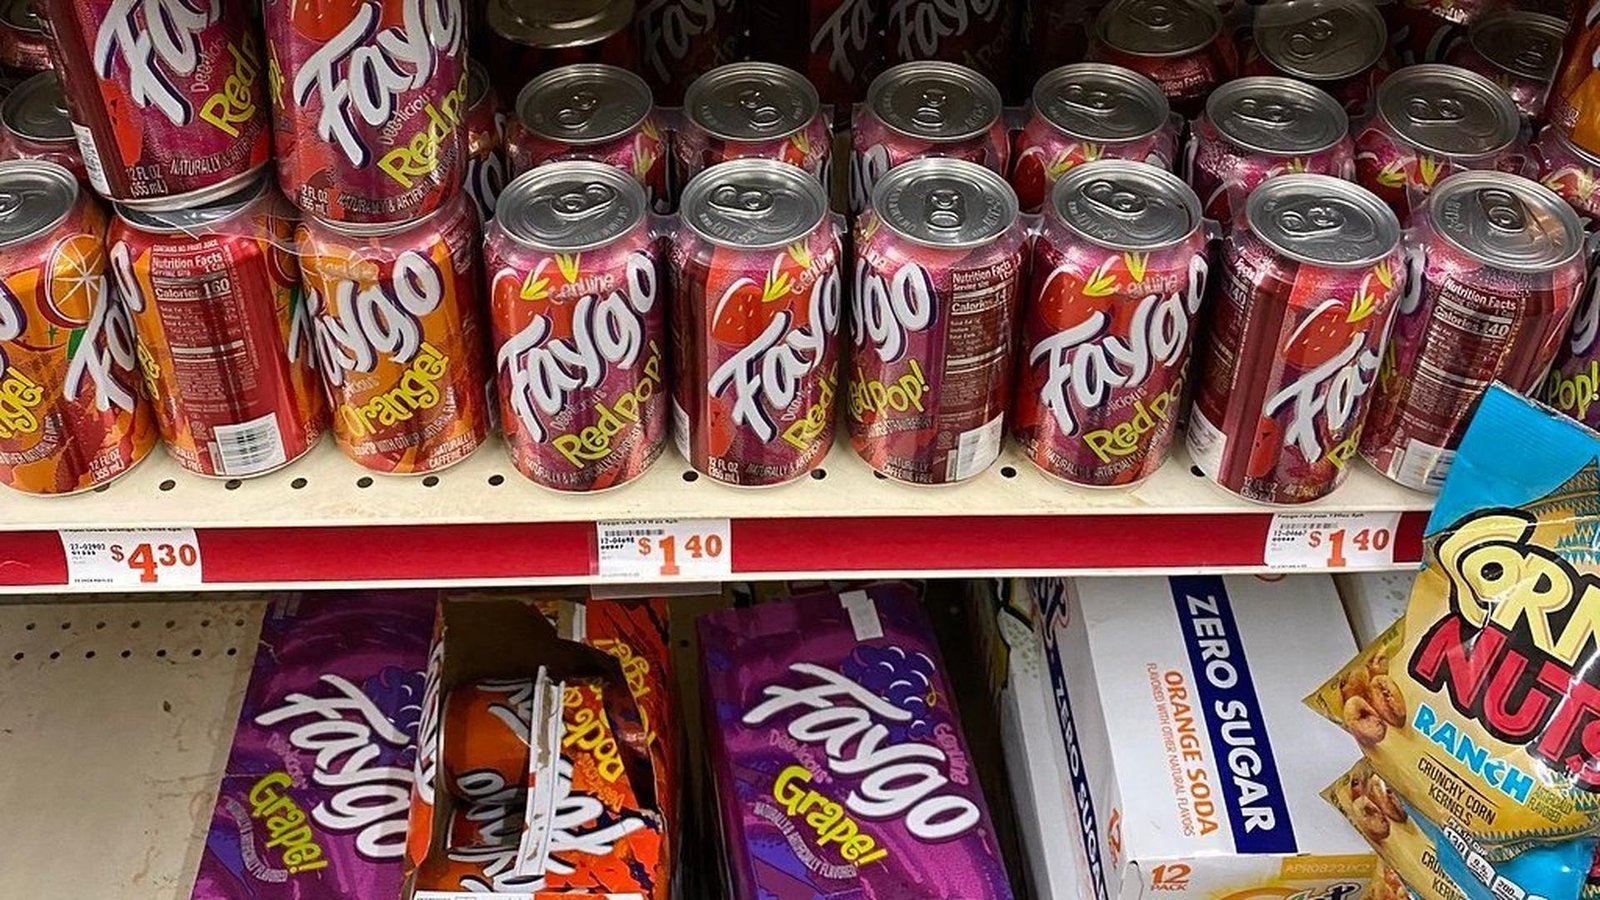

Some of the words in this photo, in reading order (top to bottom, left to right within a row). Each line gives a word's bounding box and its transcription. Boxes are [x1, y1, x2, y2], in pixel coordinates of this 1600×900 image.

[152, 256, 194, 269] Nutrition
[195, 252, 222, 266] Facts
[155, 288, 200, 299] Calories
[203, 278, 230, 299] 160
[1444, 278, 1488, 305] Nutrition
[1488, 295, 1516, 310] Facts
[498, 250, 656, 443] Faygo
[1030, 253, 1209, 438] Faygo
[1433, 304, 1480, 331] Calories
[1482, 318, 1509, 337] 140
[340, 341, 449, 438] Orange!
[1147, 662, 1165, 702] FLAVORED
[1055, 679, 1080, 778] ZERO
[1157, 702, 1170, 727] WITH
[1161, 725, 1176, 756] OTHER
[1186, 595, 1239, 690] ZERO
[1215, 699, 1277, 834] SUGAR
[742, 662, 981, 839] Faygo
[933, 722, 970, 787] Genuine
[1164, 671, 1203, 762] ORANGE
[1187, 768, 1219, 837] SODA
[1169, 755, 1185, 796] NATURAL
[1412, 702, 1535, 804] RANCH
[773, 764, 889, 867] Grape!
[1177, 797, 1196, 837] FLAVORS
[1418, 757, 1468, 802] CRUNCHY
[1467, 794, 1497, 826] CORN
[1428, 785, 1474, 827] KERNELS
[249, 771, 329, 874] Grape!
[1151, 862, 1191, 884] 12
[1151, 883, 1188, 892] PACK
